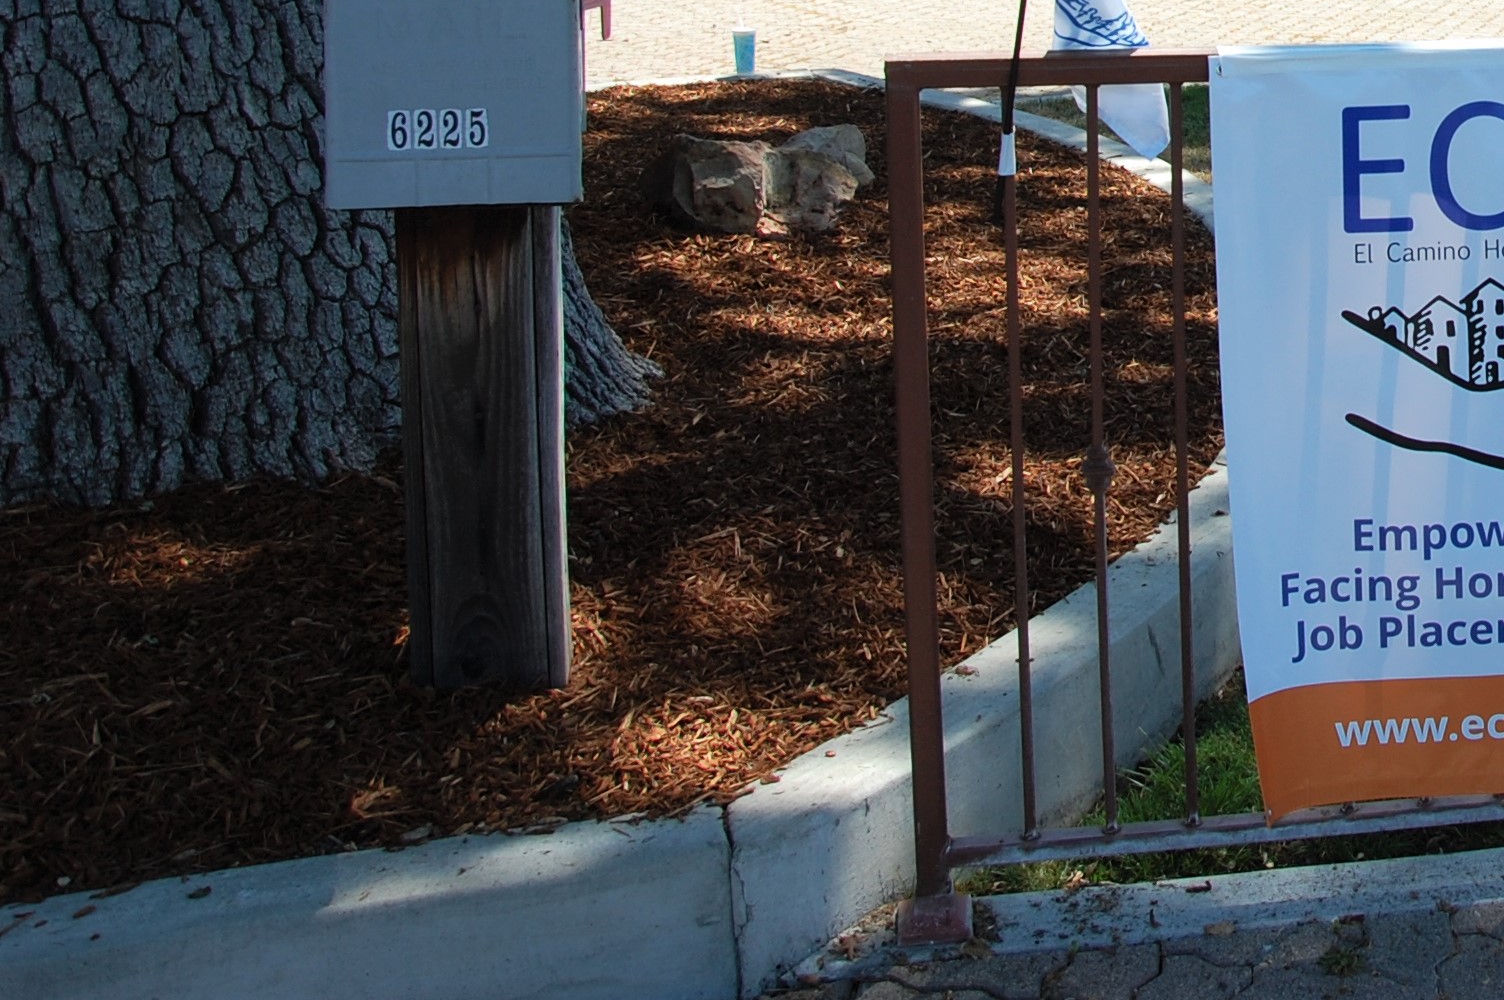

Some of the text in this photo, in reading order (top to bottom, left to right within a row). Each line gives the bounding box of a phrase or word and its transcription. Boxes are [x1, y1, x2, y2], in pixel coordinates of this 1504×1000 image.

[390, 110, 487, 149] 6225
[1354, 243, 1373, 264] El
[1386, 241, 1471, 263] Camino
[1280, 567, 1421, 611] Facing
[1291, 616, 1363, 664] Job
